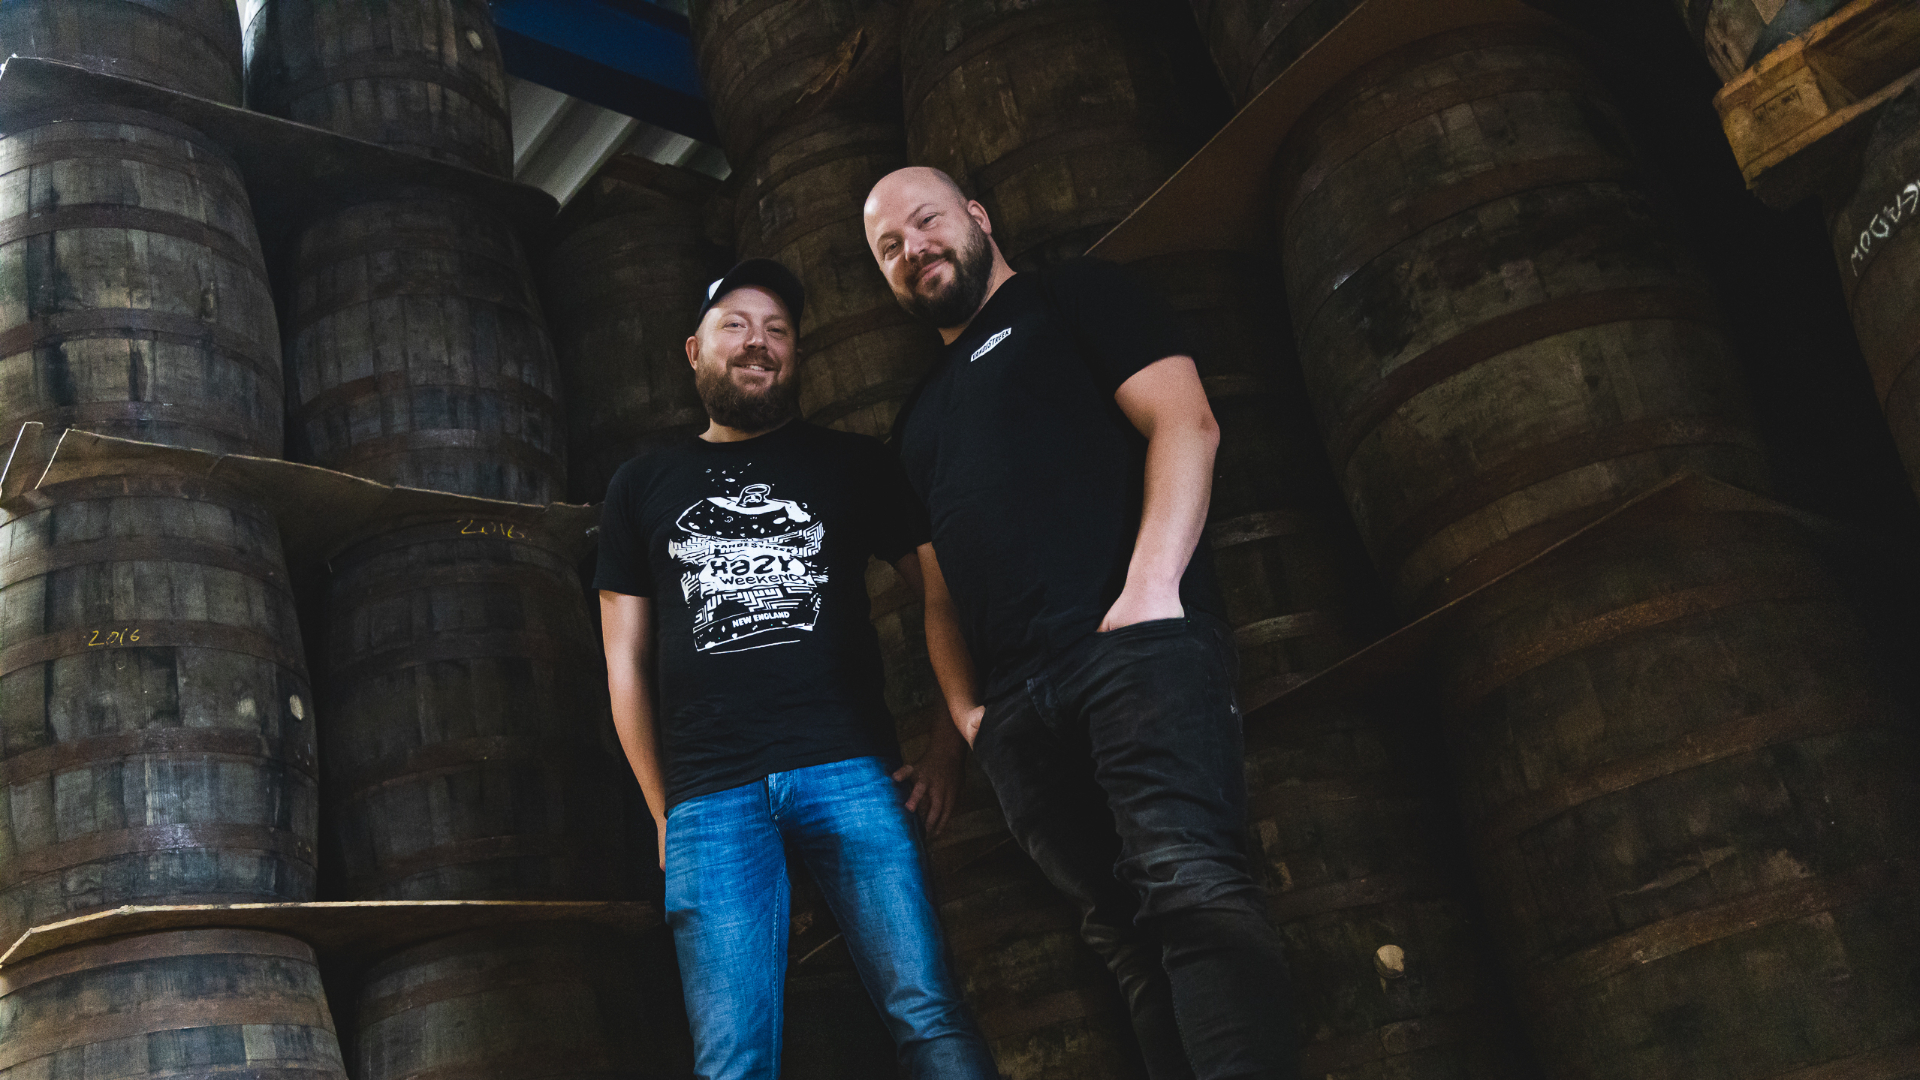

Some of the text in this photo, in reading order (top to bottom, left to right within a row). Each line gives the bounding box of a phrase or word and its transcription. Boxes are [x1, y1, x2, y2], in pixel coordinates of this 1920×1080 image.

[1850, 179, 1920, 277] EADOW
[732, 611, 790, 628] NEW ENGLAND
[88, 628, 140, 646] 2016
